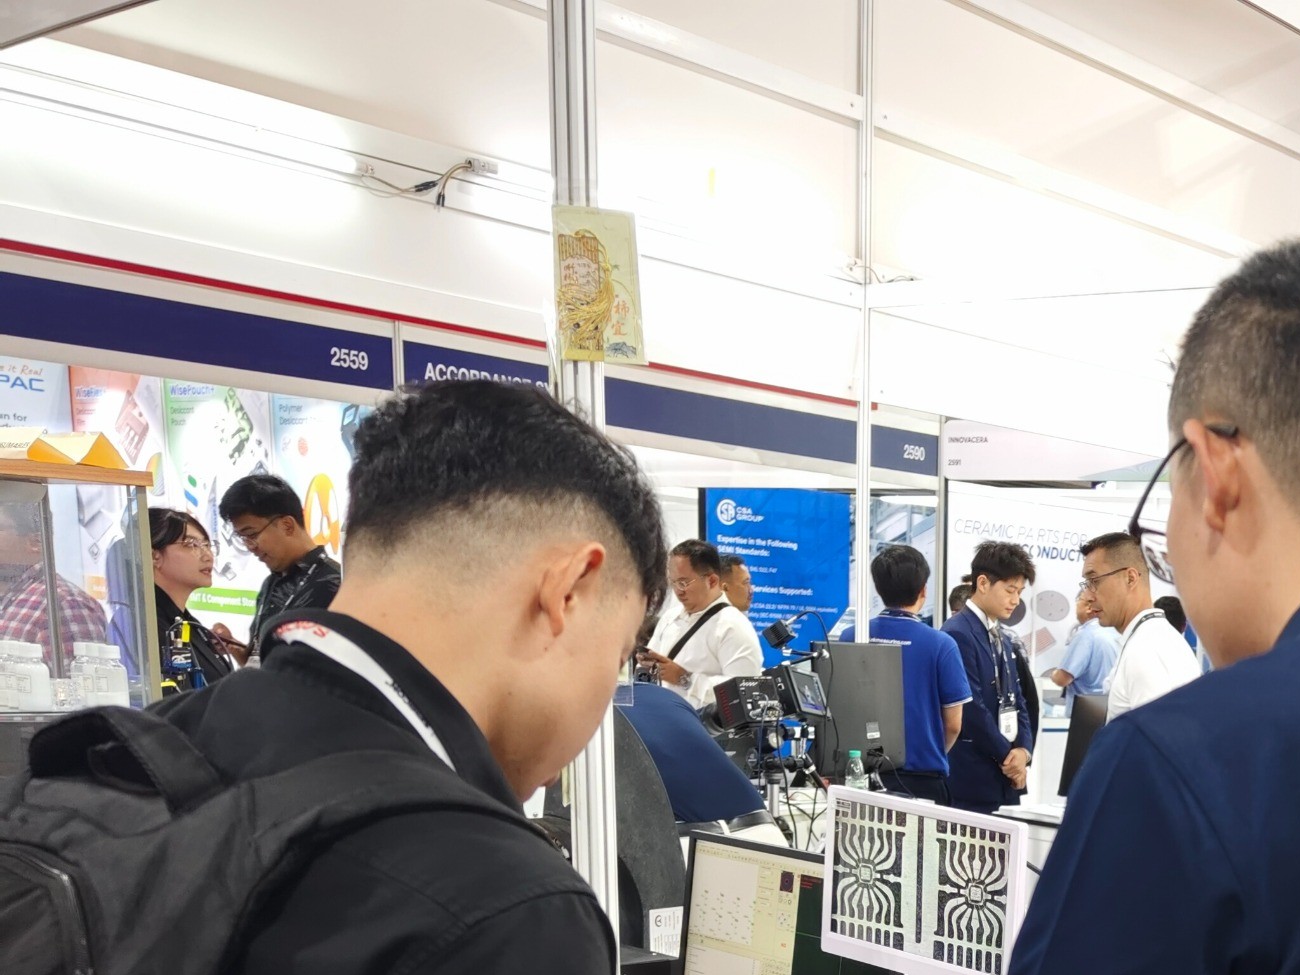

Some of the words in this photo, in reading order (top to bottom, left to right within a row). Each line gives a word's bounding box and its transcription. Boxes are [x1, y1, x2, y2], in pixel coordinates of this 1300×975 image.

[330, 347, 369, 371] 2559
[948, 436, 989, 444] INNOVACERA
[903, 444, 926, 462] 2590
[735, 513, 765, 523] GROUP
[736, 506, 753, 515] CSA
[954, 518, 1015, 540] CERAMIC
[717, 534, 748, 546] Expertise
[767, 539, 799, 551] Following
